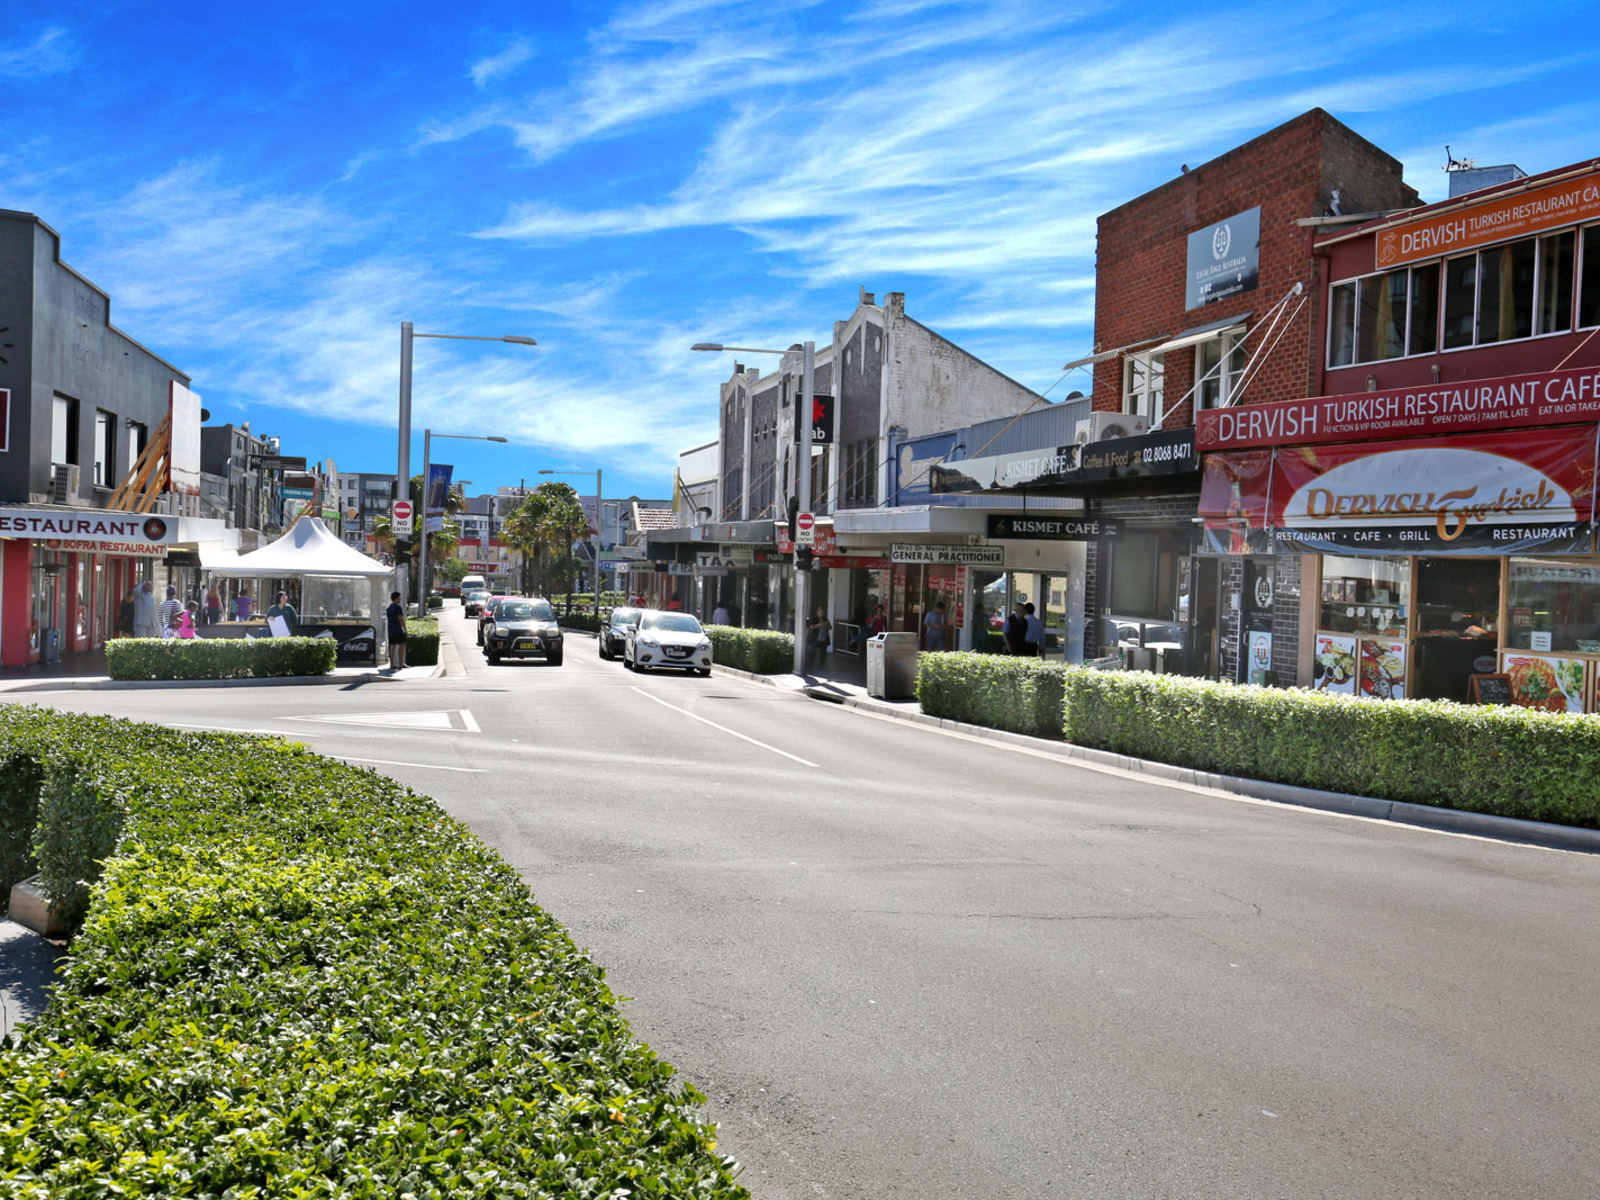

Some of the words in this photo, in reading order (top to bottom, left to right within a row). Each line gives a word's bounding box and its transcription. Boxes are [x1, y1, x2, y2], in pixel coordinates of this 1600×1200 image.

[1402, 219, 1466, 255] DERVISH
[1469, 208, 1511, 231] TURKISH
[1512, 190, 1582, 221] RESTAURANT
[1219, 405, 1318, 442] DERVISH
[1323, 396, 1399, 424] TURKISH
[1404, 381, 1541, 416] RESTAURANT
[1323, 424, 1354, 433] FUNCTION
[1360, 422, 1370, 431] VIP
[1370, 420, 1389, 430] ROOM
[1391, 416, 1425, 428] AVAILABLE
[1432, 415, 1451, 424] OPEN
[1453, 415, 1457, 423] 7
[1458, 413, 1477, 422] DAYS
[1482, 412, 1497, 421] 7AM
[1499, 411, 1509, 419] TIL
[1511, 408, 1529, 418] LATE
[1539, 405, 1552, 415] EAT
[1554, 404, 1563, 413] IN
[1564, 403, 1577, 412] OR
[1578, 401, 1600, 412] TAKE
[1083, 455, 1102, 469] Coffee
[1104, 453, 1110, 467] &
[1111, 451, 1128, 466] Food
[1143, 448, 1152, 462] 02
[1154, 445, 1171, 462] 8068
[1173, 443, 1191, 460] 8471
[1006, 458, 1040, 479] KISMET
[1041, 449, 1067, 475] CAFÉ
[1307, 488, 1436, 519] DERVISH
[1012, 521, 1063, 533] KISMET
[1065, 520, 1100, 534] CAFÉ
[1276, 531, 1336, 541] RESTAURANT
[1354, 531, 1381, 541] CAFE
[1400, 530, 1431, 541] GRILL
[1493, 527, 1575, 540] RESTAURANT
[63, 540, 97, 550] SOFRA
[100, 542, 165, 554] RESTAURANT
[893, 551, 934, 560] GENERAL
[939, 552, 1001, 562] PRACTITIONER
